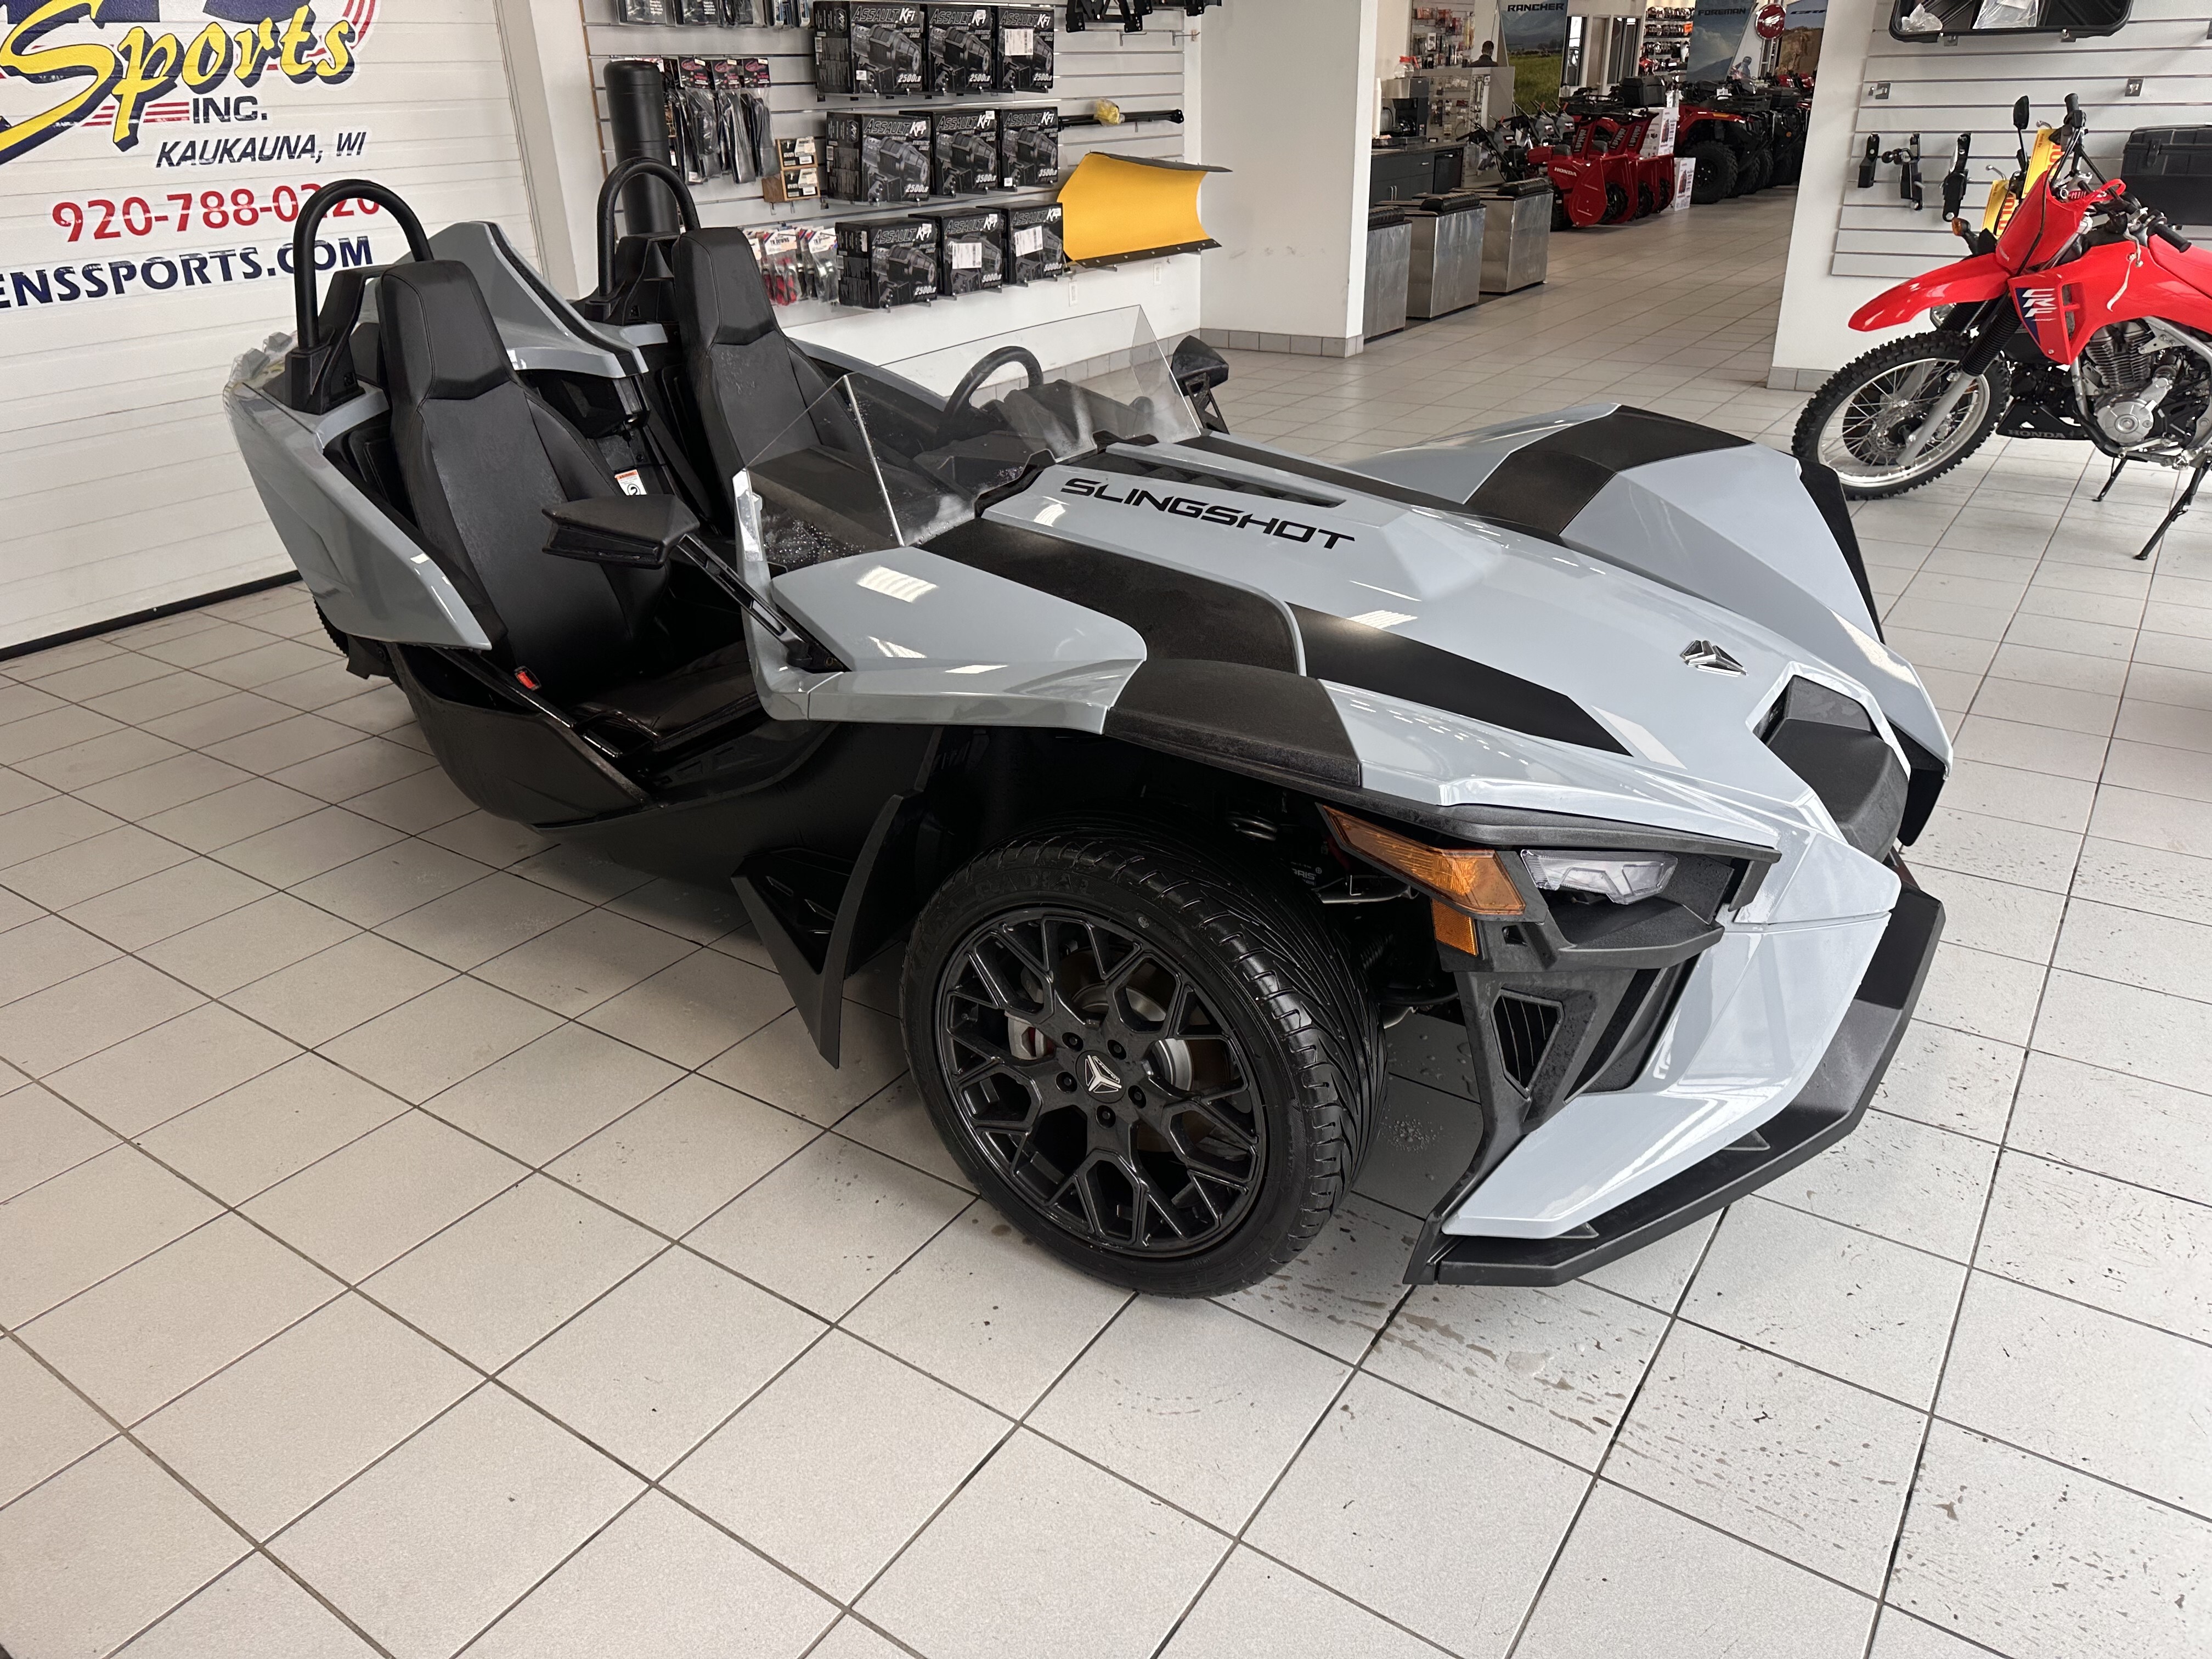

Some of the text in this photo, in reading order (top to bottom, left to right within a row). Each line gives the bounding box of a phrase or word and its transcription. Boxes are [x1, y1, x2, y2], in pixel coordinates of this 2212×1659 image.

[1507, 3, 1565, 12] RANCHER
[898, 73, 922, 83] 2500LB
[969, 72, 991, 82] 2500LB
[1033, 72, 1053, 82] 2500LB
[0, 0, 356, 166] Sports
[193, 95, 267, 124] INC.
[156, 131, 367, 168] KAUKAUNA, WI
[1039, 168, 1058, 177] 3500LB
[1554, 166, 1577, 177] HONDA
[975, 174, 997, 183] 3500LB
[905, 184, 929, 193] 2500LB
[1044, 262, 1063, 272] 5000LB
[982, 273, 1002, 283] 5000LB
[915, 285, 936, 295] 2500LB
[2022, 288, 2057, 318] CRF
[2008, 429, 2066, 438] HONDA
[1060, 478, 1356, 550] SLINGSHOT
